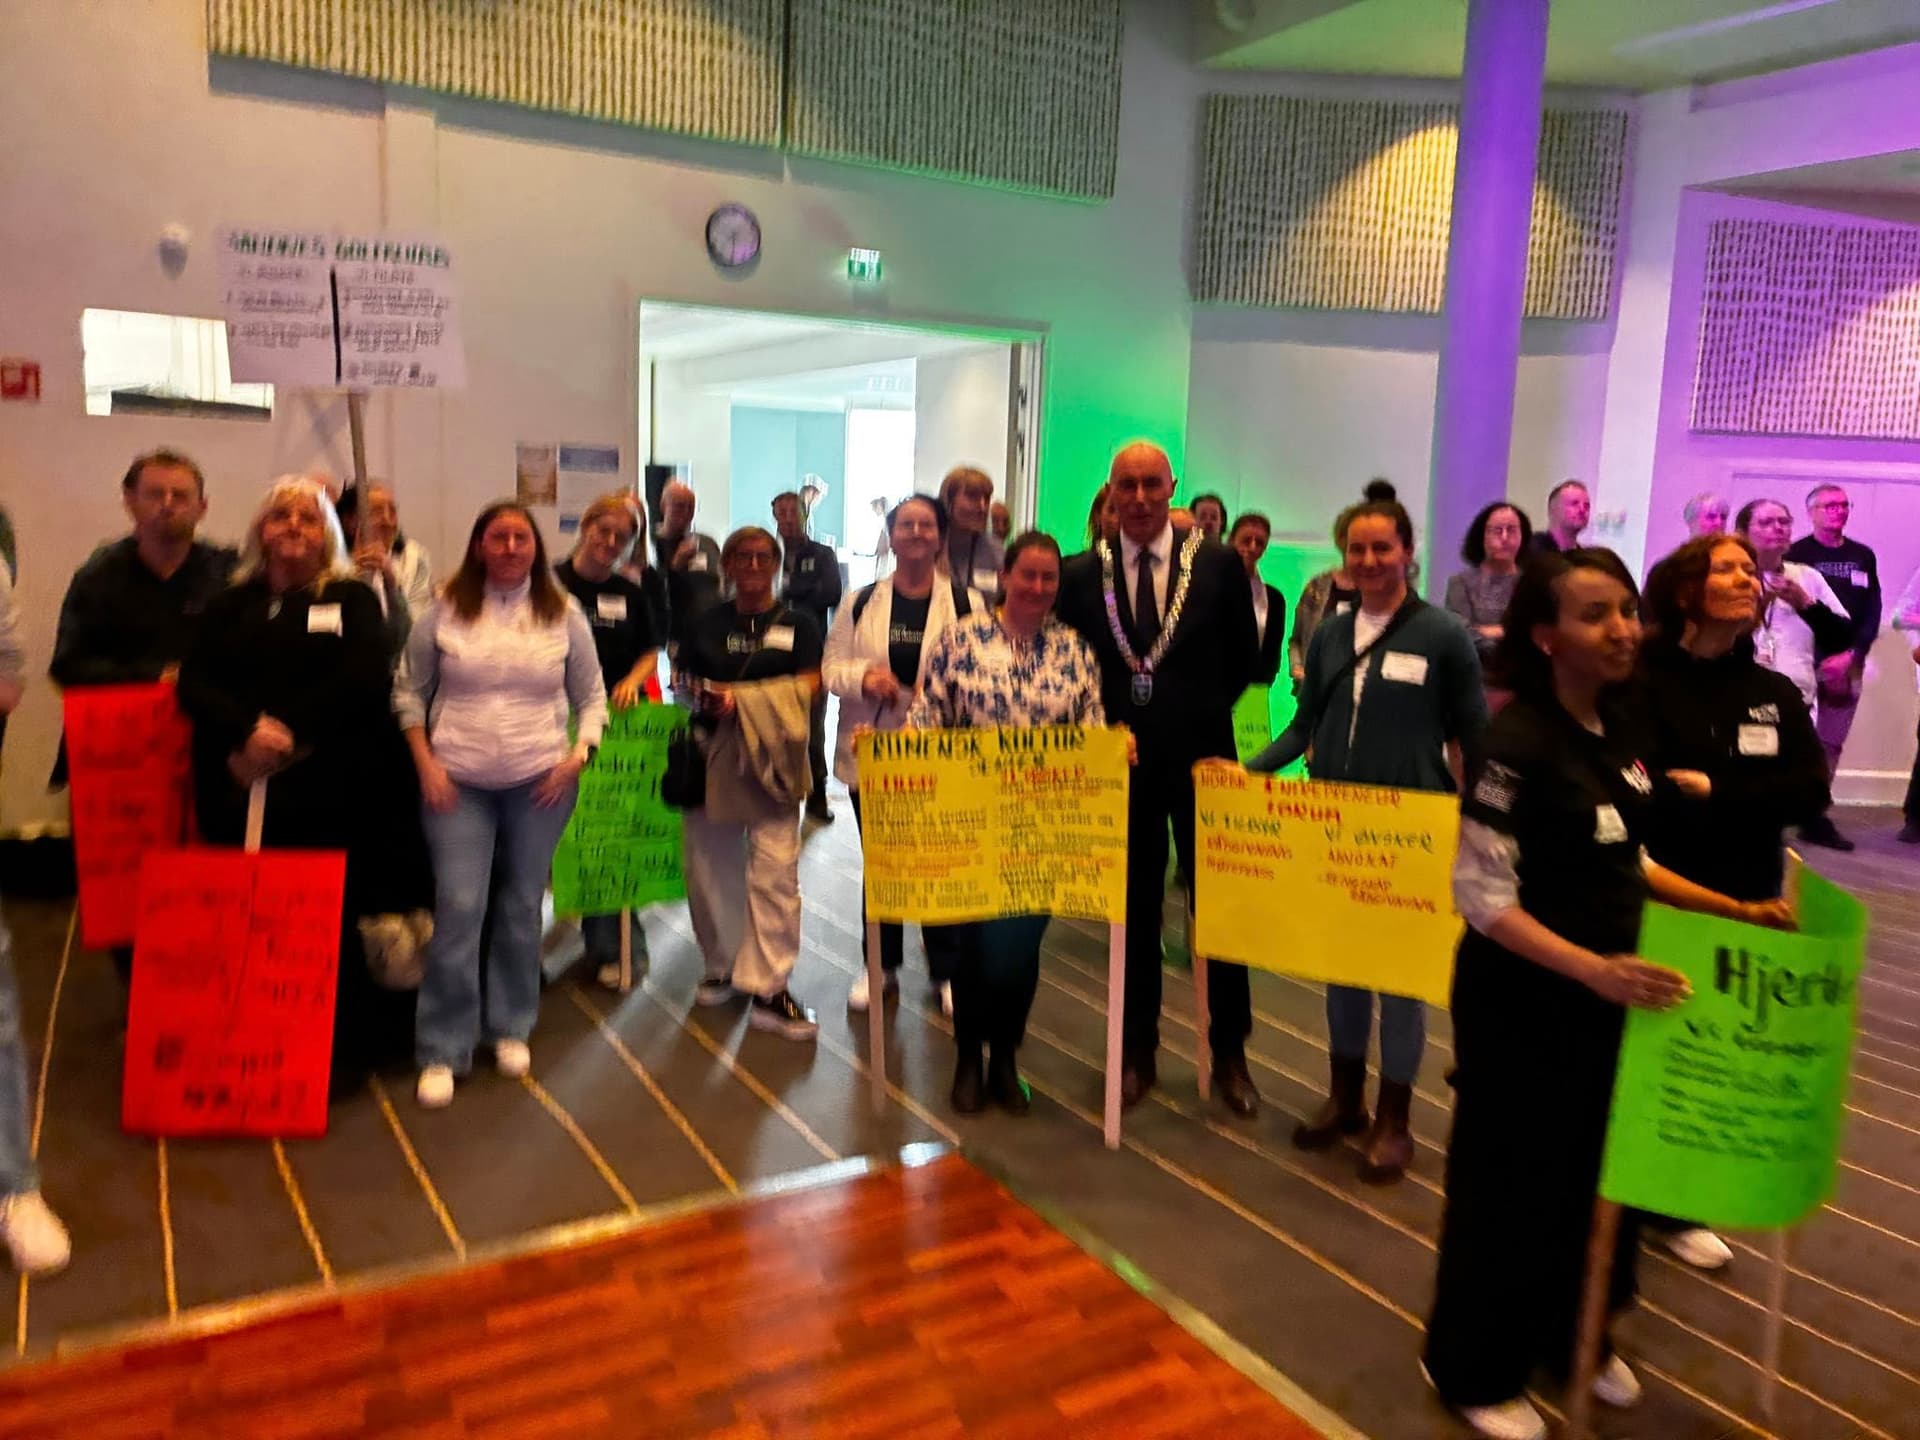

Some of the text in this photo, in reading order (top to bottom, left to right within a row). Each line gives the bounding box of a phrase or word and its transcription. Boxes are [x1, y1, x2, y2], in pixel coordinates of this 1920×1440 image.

[998, 724, 1085, 752] KULTUR
[1354, 827, 1433, 854] ØNSKER
[1328, 848, 1399, 870] ADVOKAT
